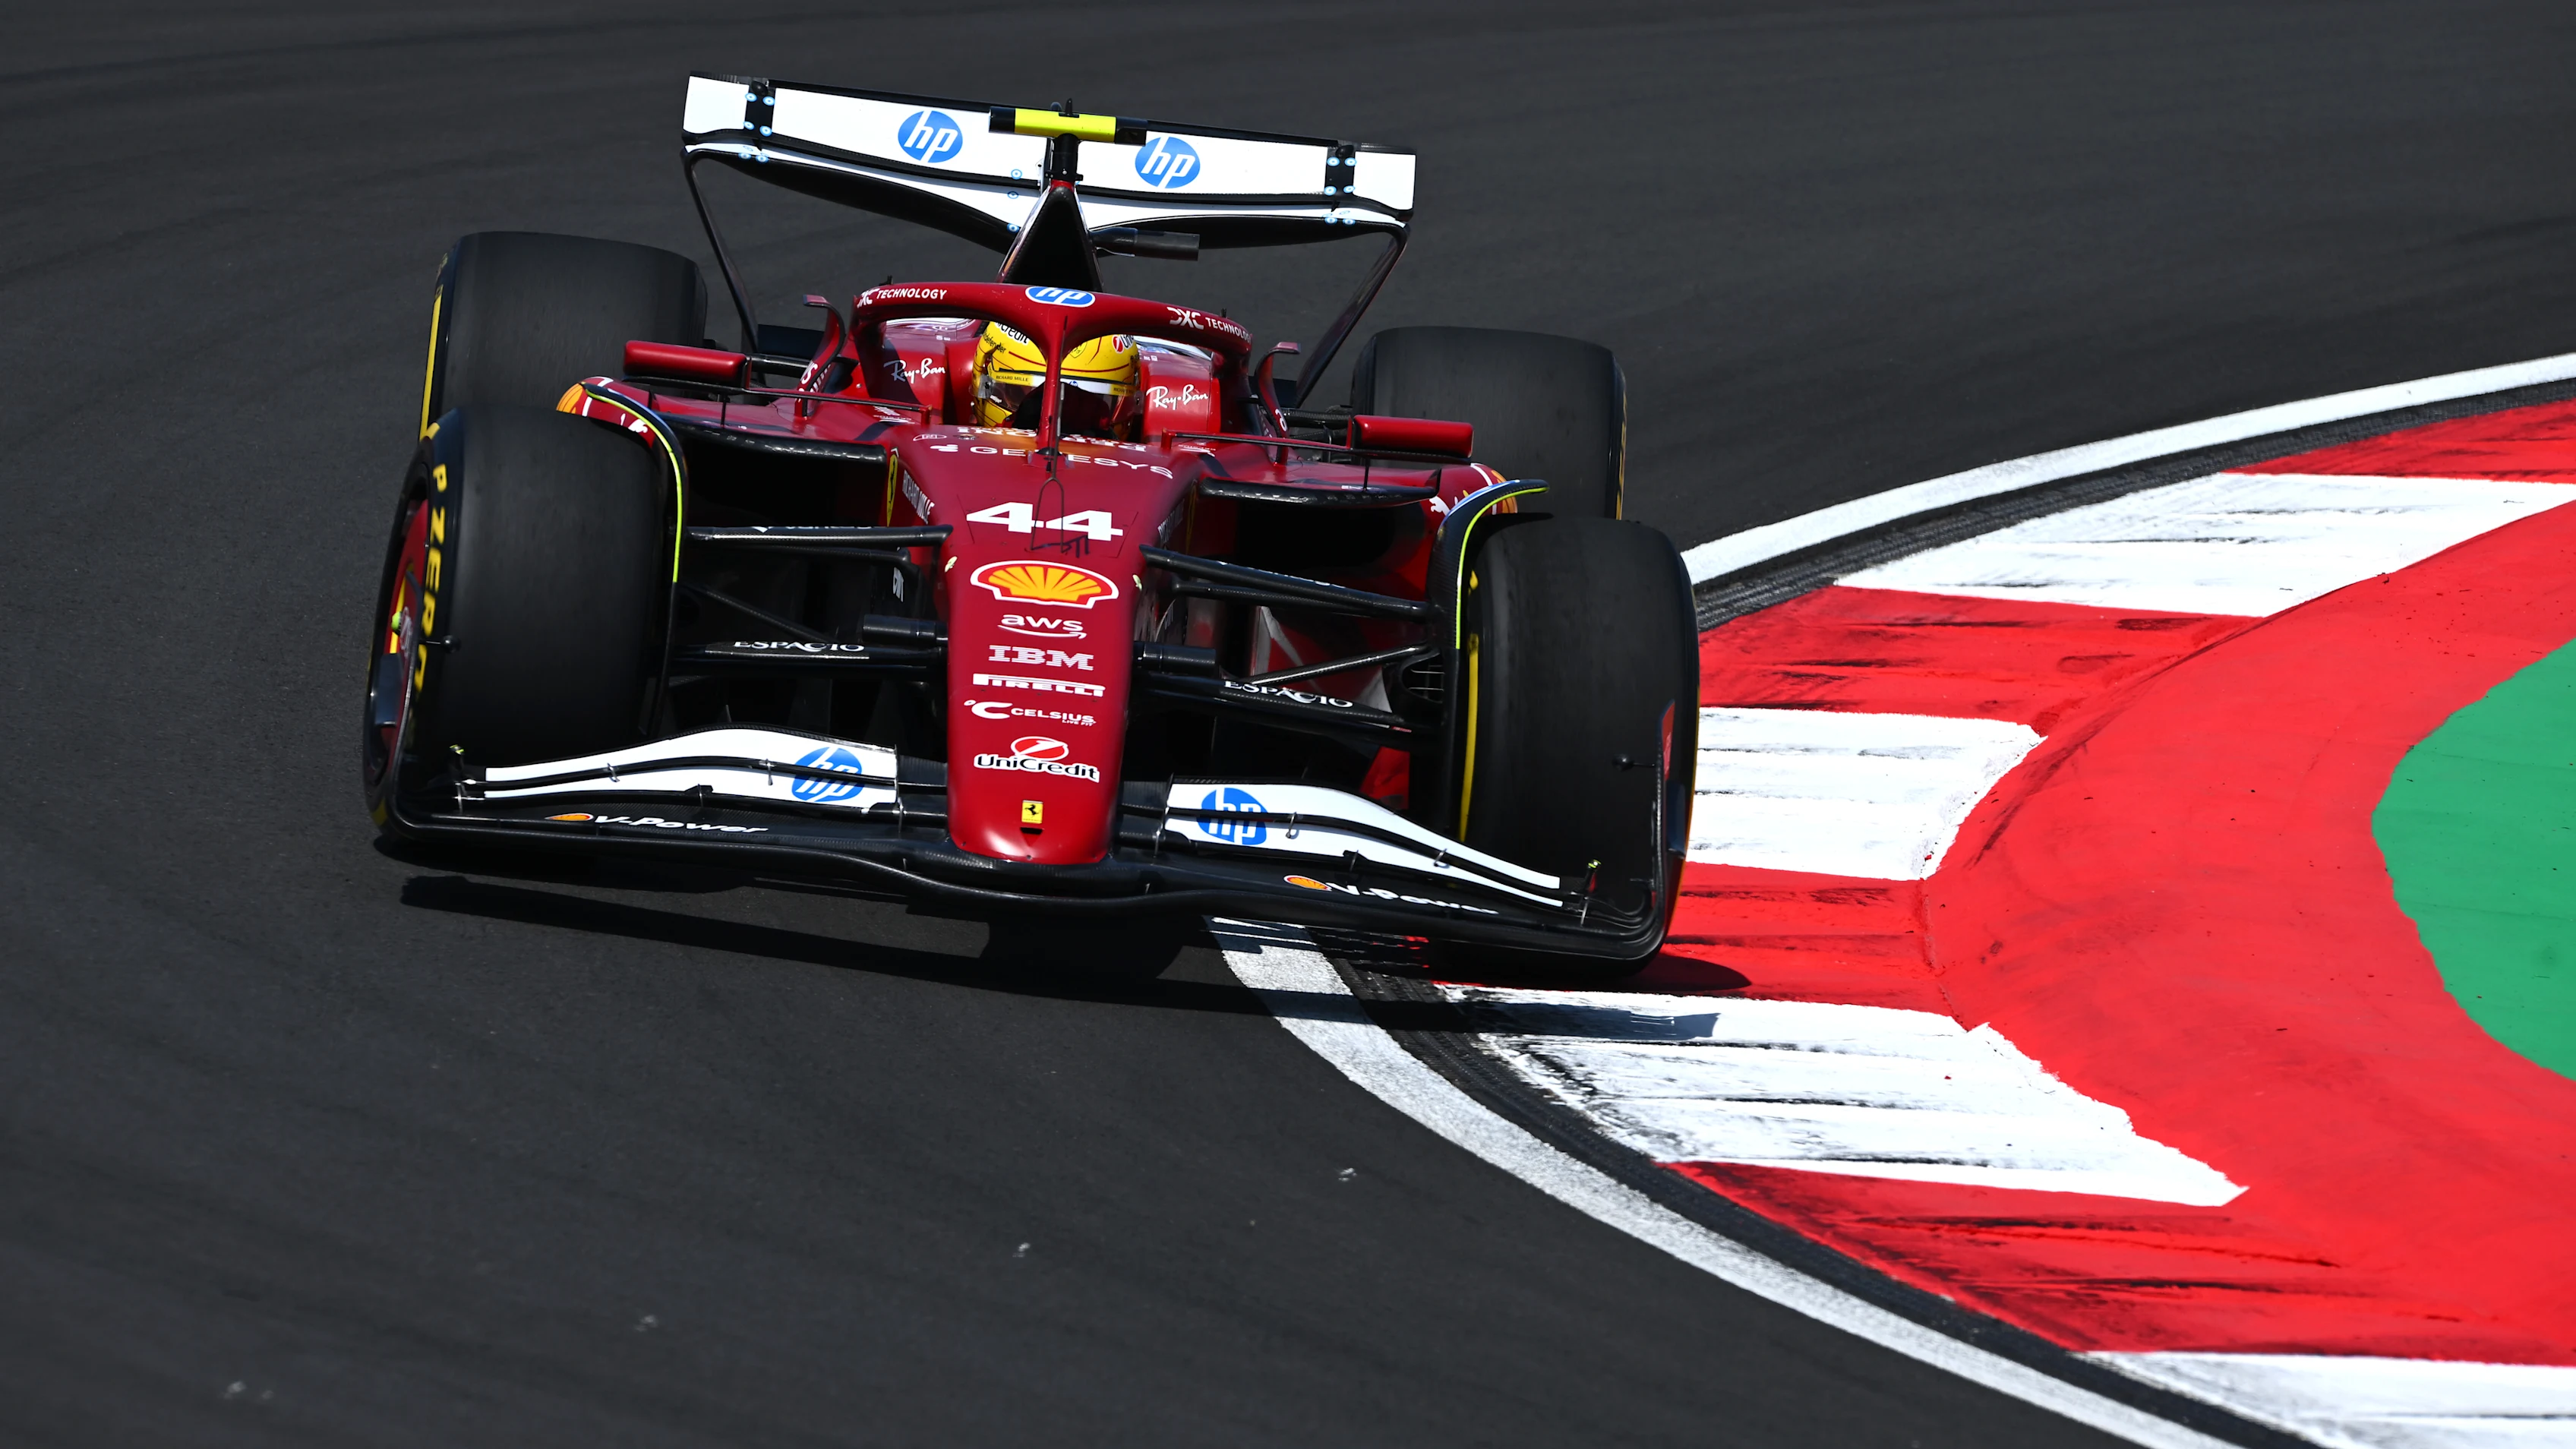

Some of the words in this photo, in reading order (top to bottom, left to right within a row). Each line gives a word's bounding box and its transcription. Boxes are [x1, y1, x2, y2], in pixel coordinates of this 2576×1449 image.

[904, 111, 959, 163] hp
[1141, 137, 1196, 188] hp
[876, 288, 947, 300] TECHNOLOGY
[1035, 288, 1087, 304] hp
[1166, 306, 1204, 330] DXC
[433, 463, 448, 492] P
[967, 502, 1123, 541] 44
[1001, 614, 1084, 632] aws
[989, 645, 1094, 671] IBM
[973, 674, 1106, 697] PIRELLI
[1011, 708, 1094, 722] CELSIUS
[977, 755, 1097, 780] UniCredit
[595, 815, 769, 833] V-Power
